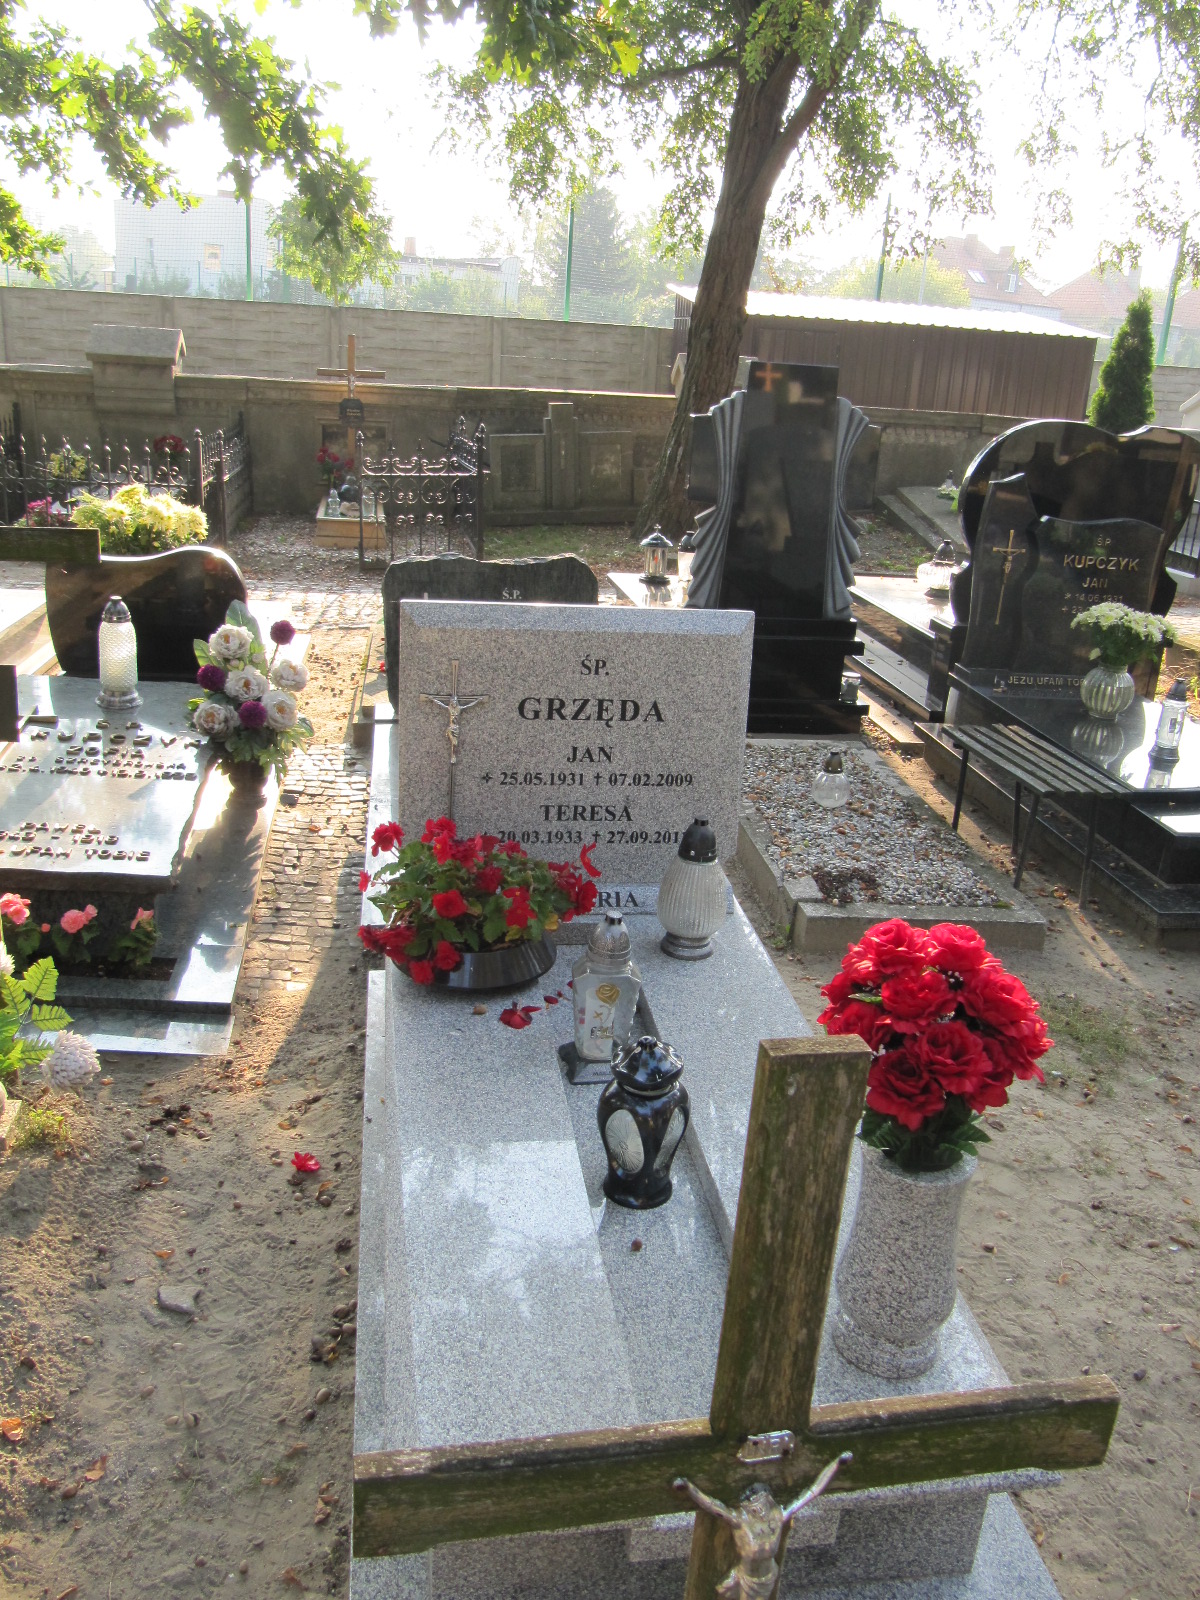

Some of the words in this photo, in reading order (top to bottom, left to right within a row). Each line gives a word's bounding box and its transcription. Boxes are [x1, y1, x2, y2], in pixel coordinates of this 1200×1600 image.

[1063, 554, 1140, 571] KUPCZYK
[1082, 577, 1108, 588] JAN
[502, 587, 522, 600] Ś.P.
[580, 654, 610, 676] ŚP.
[1008, 676, 1033, 685] JEZU
[1037, 677, 1063, 686] UFAM
[518, 697, 664, 728] GRZĘDA
[567, 745, 614, 763] JAN
[499, 772, 585, 787] 25.05.1931
[608, 772, 694, 787] 07.02.2009
[539, 804, 634, 822] TERESA
[498, 830, 583, 844] 20.03.1933
[606, 830, 687, 844] 27.09.201
